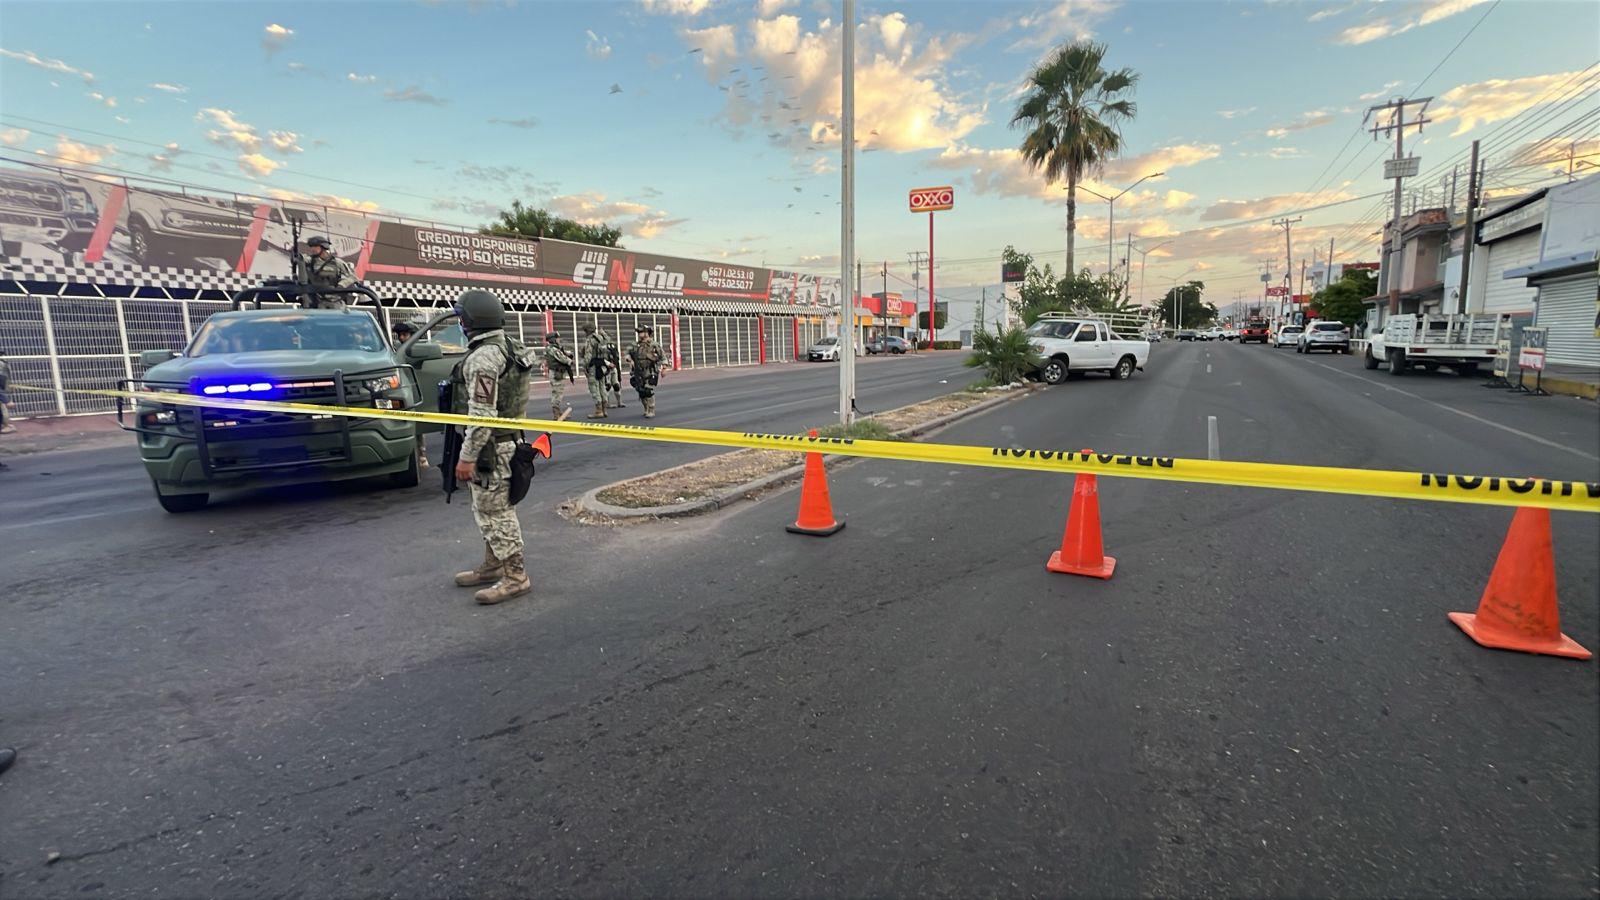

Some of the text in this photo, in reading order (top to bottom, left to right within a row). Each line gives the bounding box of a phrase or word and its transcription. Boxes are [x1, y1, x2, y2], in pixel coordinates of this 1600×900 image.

[911, 189, 952, 207] OXXO
[417, 230, 535, 255] CREDITO DISPONIBLE
[420, 244, 535, 268] HASTA 60 MESES
[581, 250, 609, 264] AUTOS
[572, 262, 609, 285] EL
